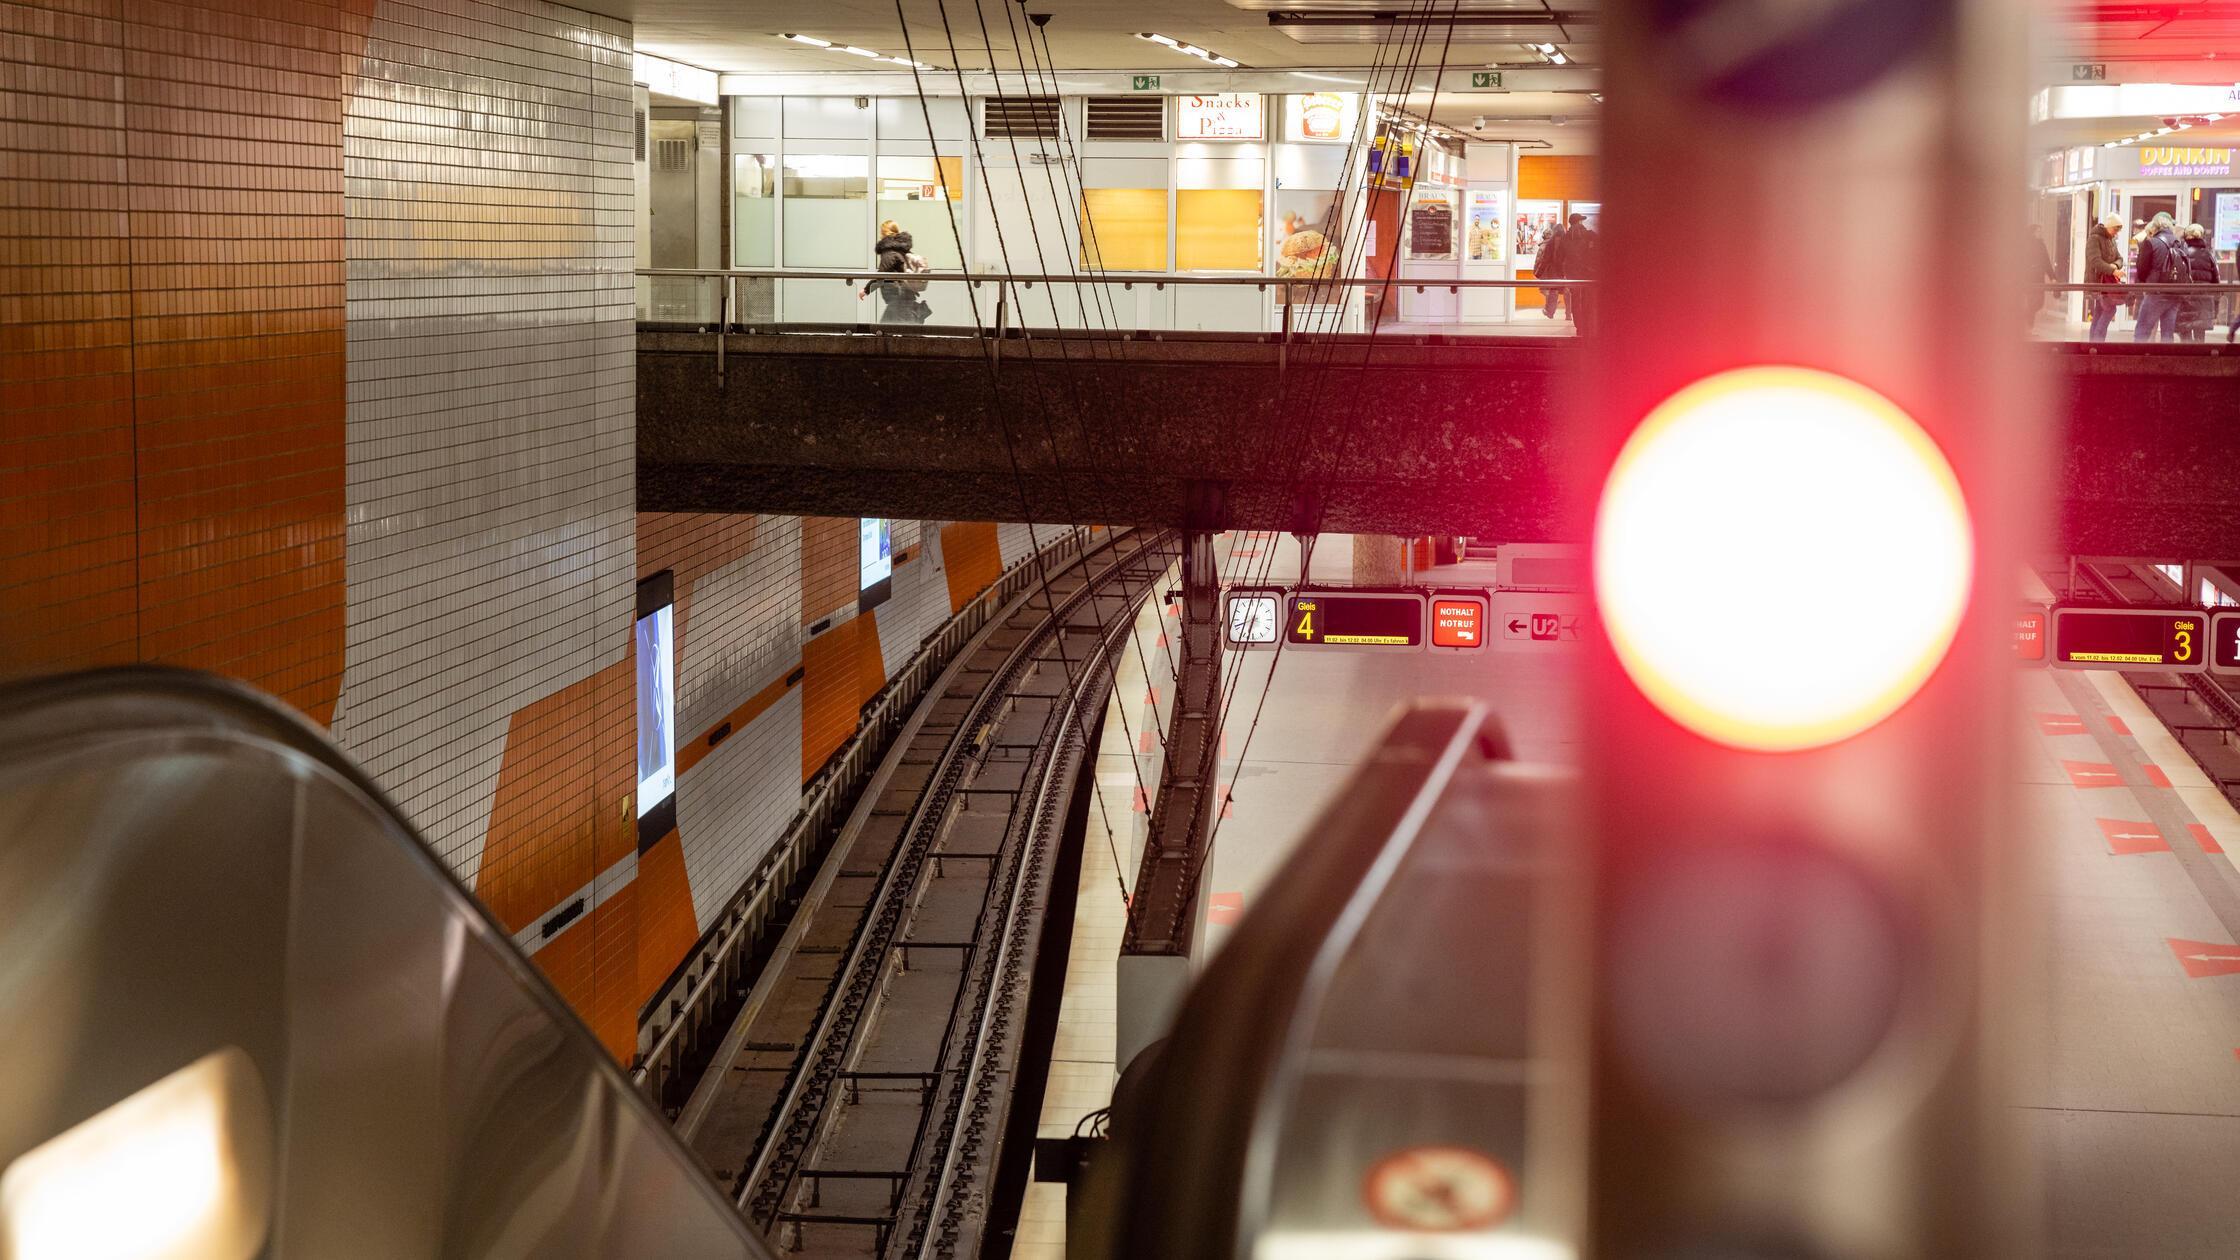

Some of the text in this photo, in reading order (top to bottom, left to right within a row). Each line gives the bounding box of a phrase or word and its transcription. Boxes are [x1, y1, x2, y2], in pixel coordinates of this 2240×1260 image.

[1191, 94, 1250, 108] Snacks
[1216, 112, 1226, 121] &
[1200, 117, 1242, 135] Pizza
[2173, 166, 2192, 175] AND
[2193, 166, 2230, 175] DONUTS
[1298, 602, 1316, 611] Gleis
[1440, 608, 1474, 616] NOTHALT
[1297, 611, 1314, 640] 4
[1440, 620, 1474, 628] NOTRUF
[1532, 618, 1558, 636] U2
[2174, 621, 2194, 630] Gleis
[2173, 631, 2191, 661] 3
